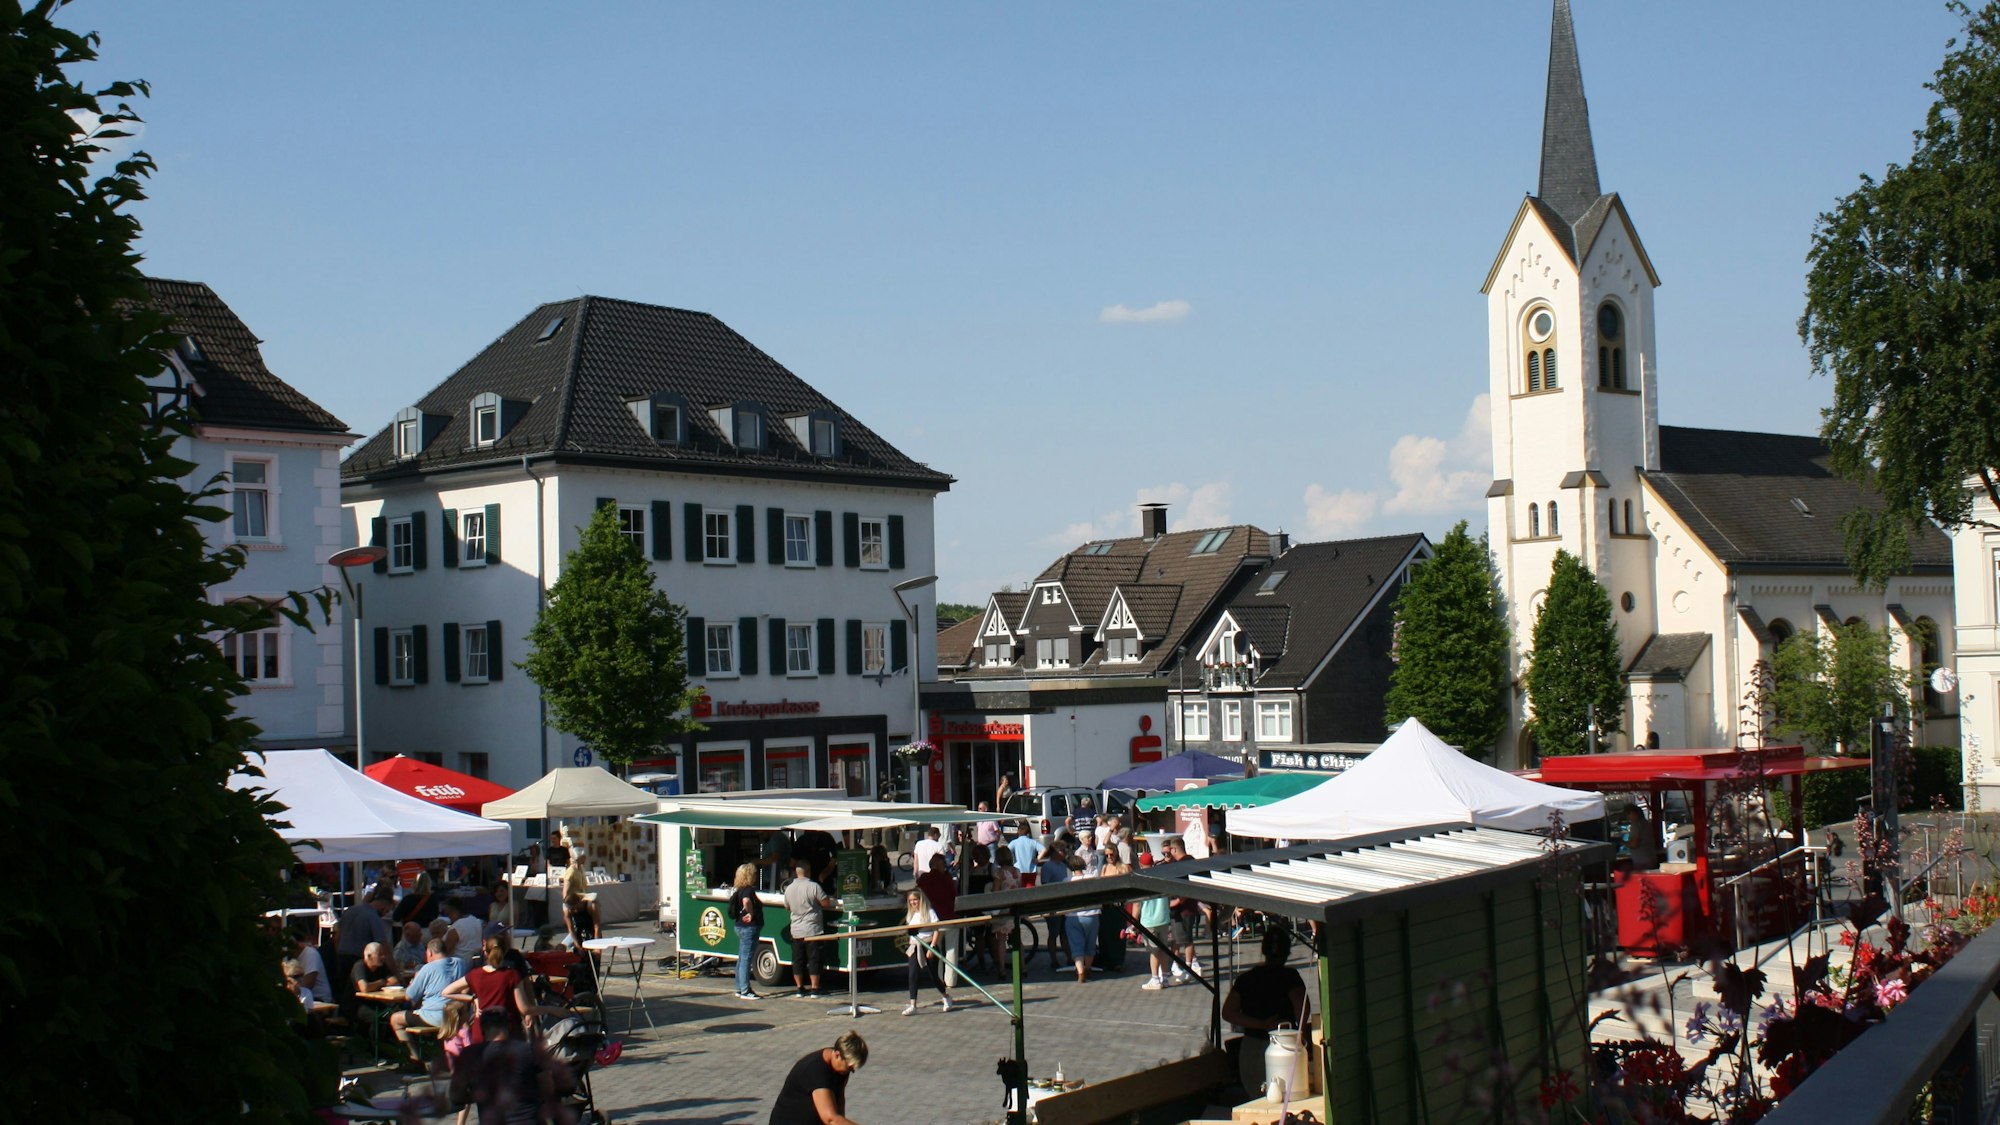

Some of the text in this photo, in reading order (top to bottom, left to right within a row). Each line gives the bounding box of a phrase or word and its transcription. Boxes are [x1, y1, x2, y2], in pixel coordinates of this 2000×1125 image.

[717, 698, 820, 719] Kreissparkasse
[1271, 751, 1304, 768] Fish
[1306, 754, 1317, 768] &
[414, 784, 465, 797] Früh
